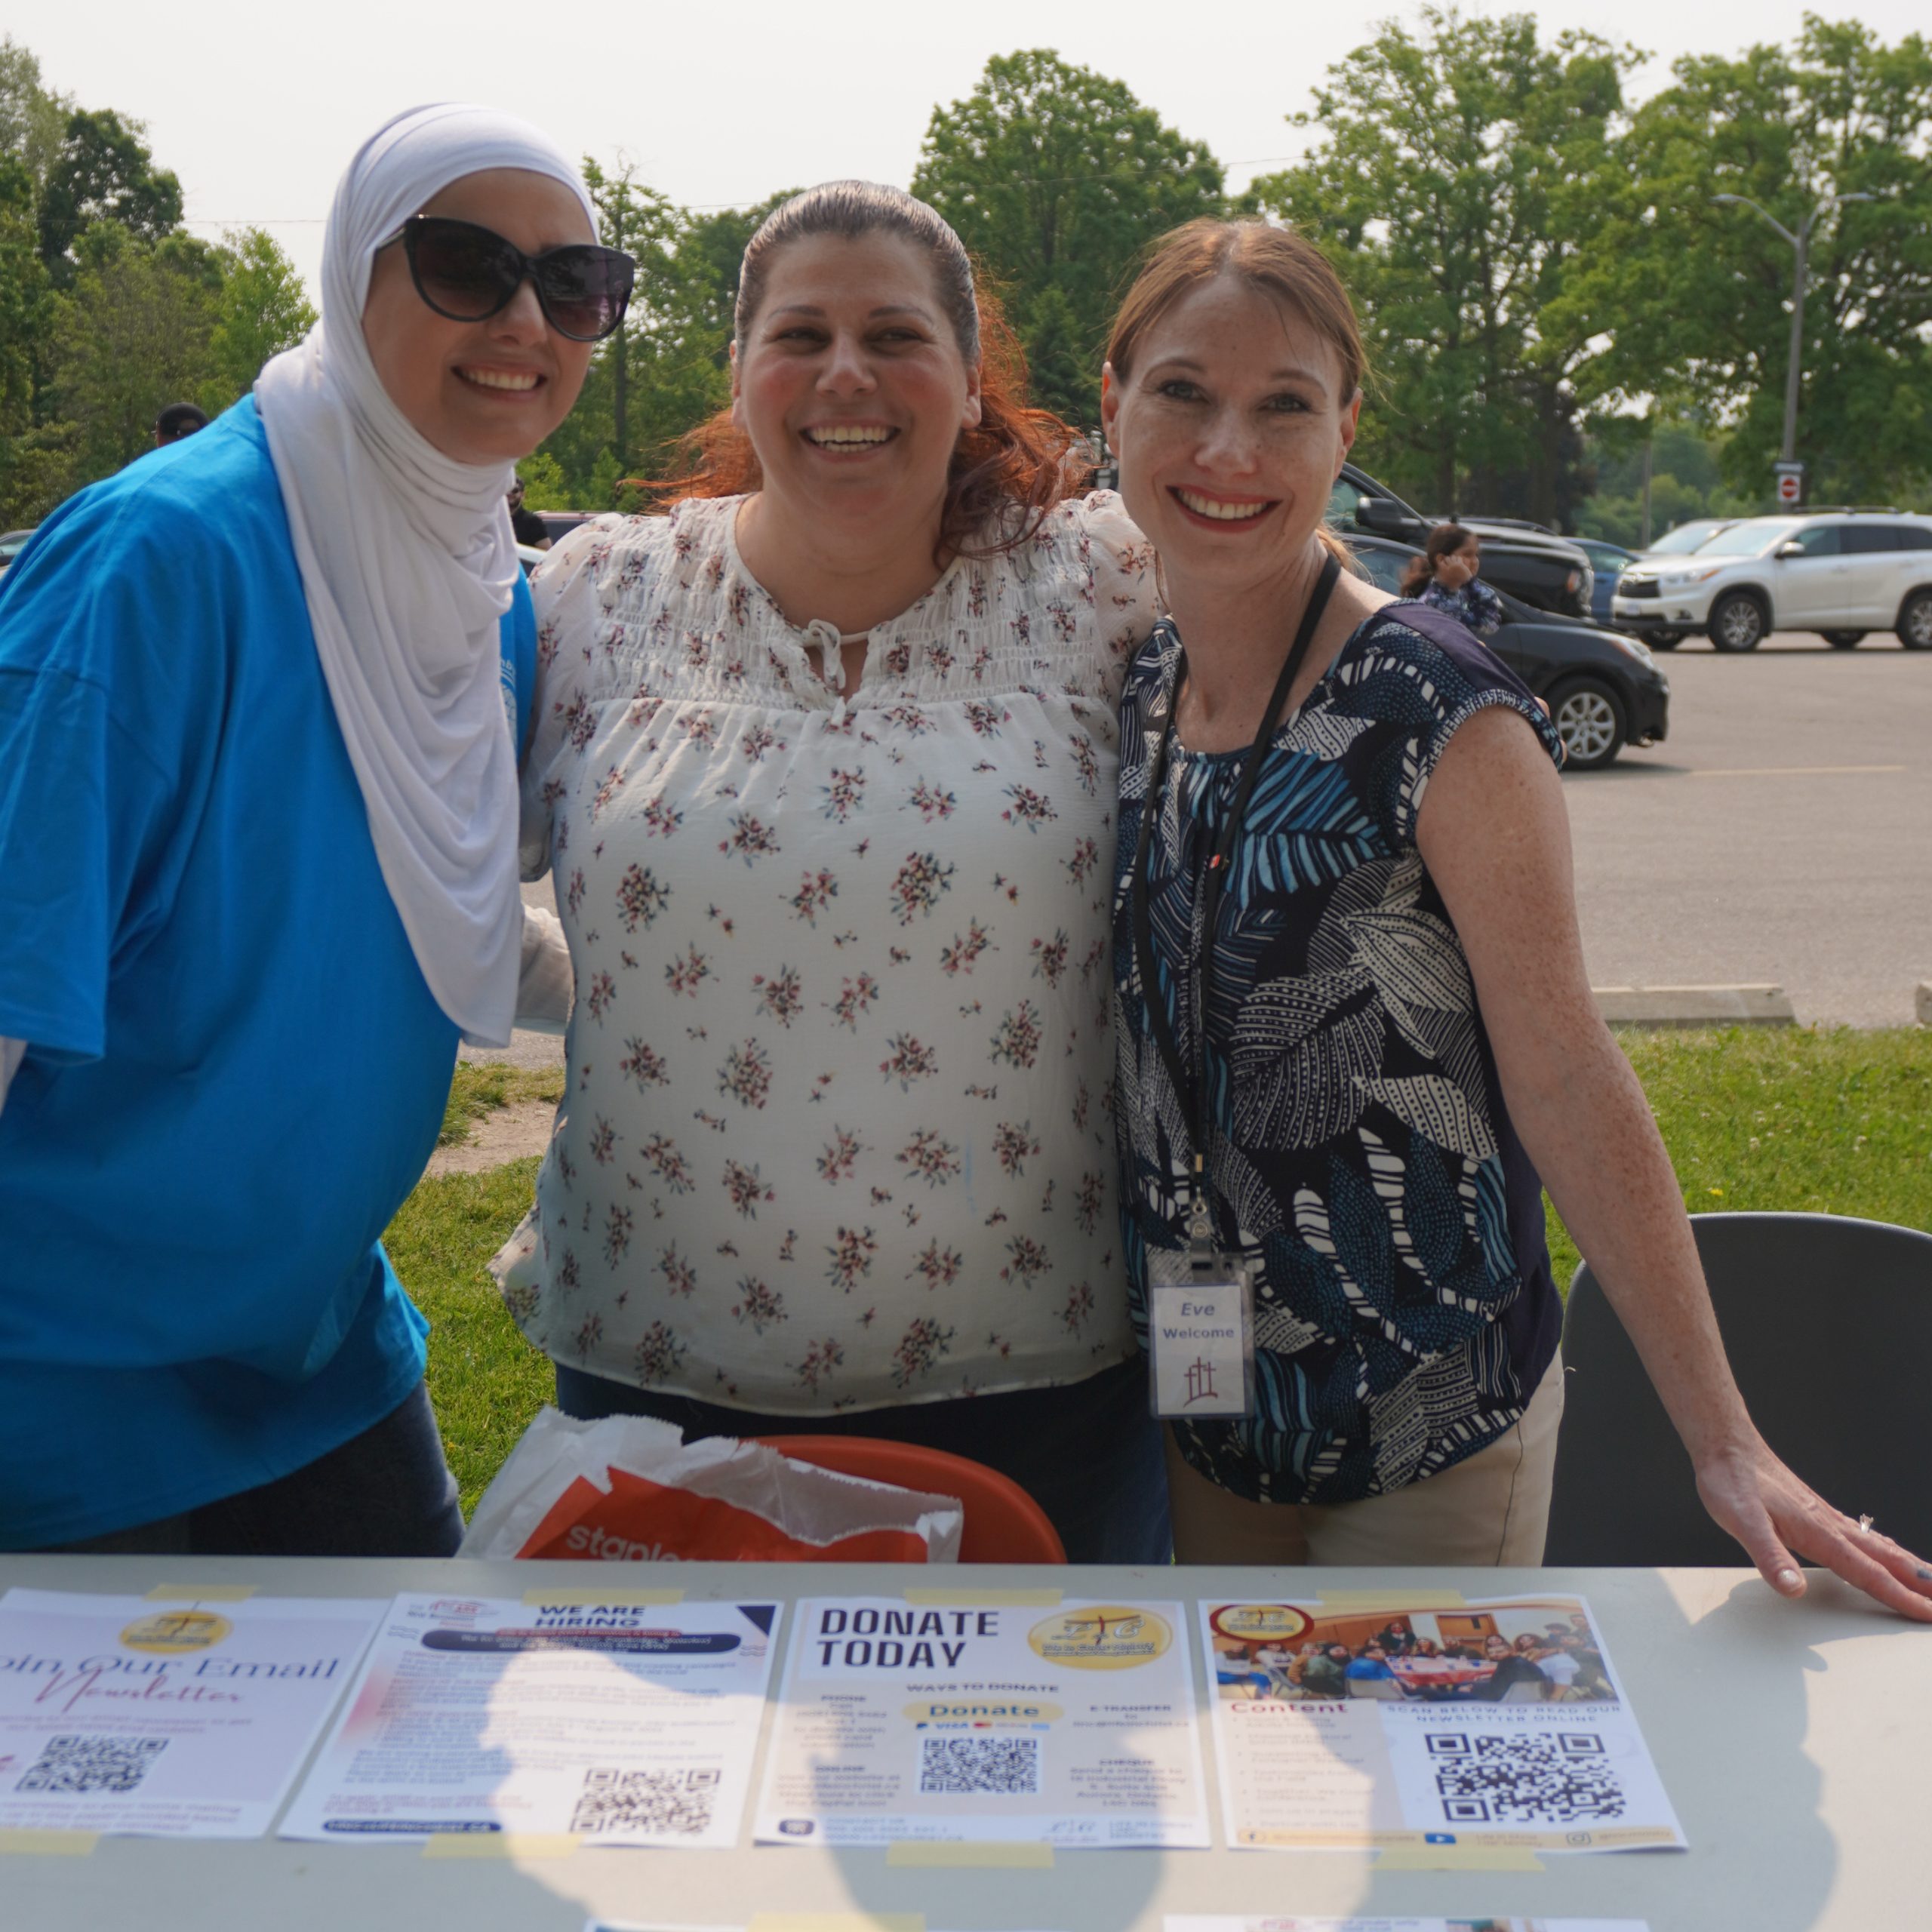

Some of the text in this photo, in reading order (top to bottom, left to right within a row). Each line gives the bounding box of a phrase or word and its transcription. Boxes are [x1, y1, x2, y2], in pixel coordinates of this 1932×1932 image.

[1180, 1303, 1215, 1316] Eve
[1163, 1327, 1235, 1340] Welcome
[540, 1605, 646, 1615] WE ARE
[535, 1617, 641, 1627] HIRING
[820, 1609, 999, 1636] DONATE
[817, 1639, 967, 1669] TODAY
[78, 1654, 183, 1674] Our
[196, 1657, 340, 1678] Email
[35, 1666, 240, 1713] Newsletter
[906, 1683, 1060, 1693] WAYS TO DONATE
[930, 1705, 1040, 1717] Donate
[1231, 1701, 1348, 1713] Content
[1387, 1705, 1432, 1714] SCAN
[1440, 1706, 1498, 1714] BELOW
